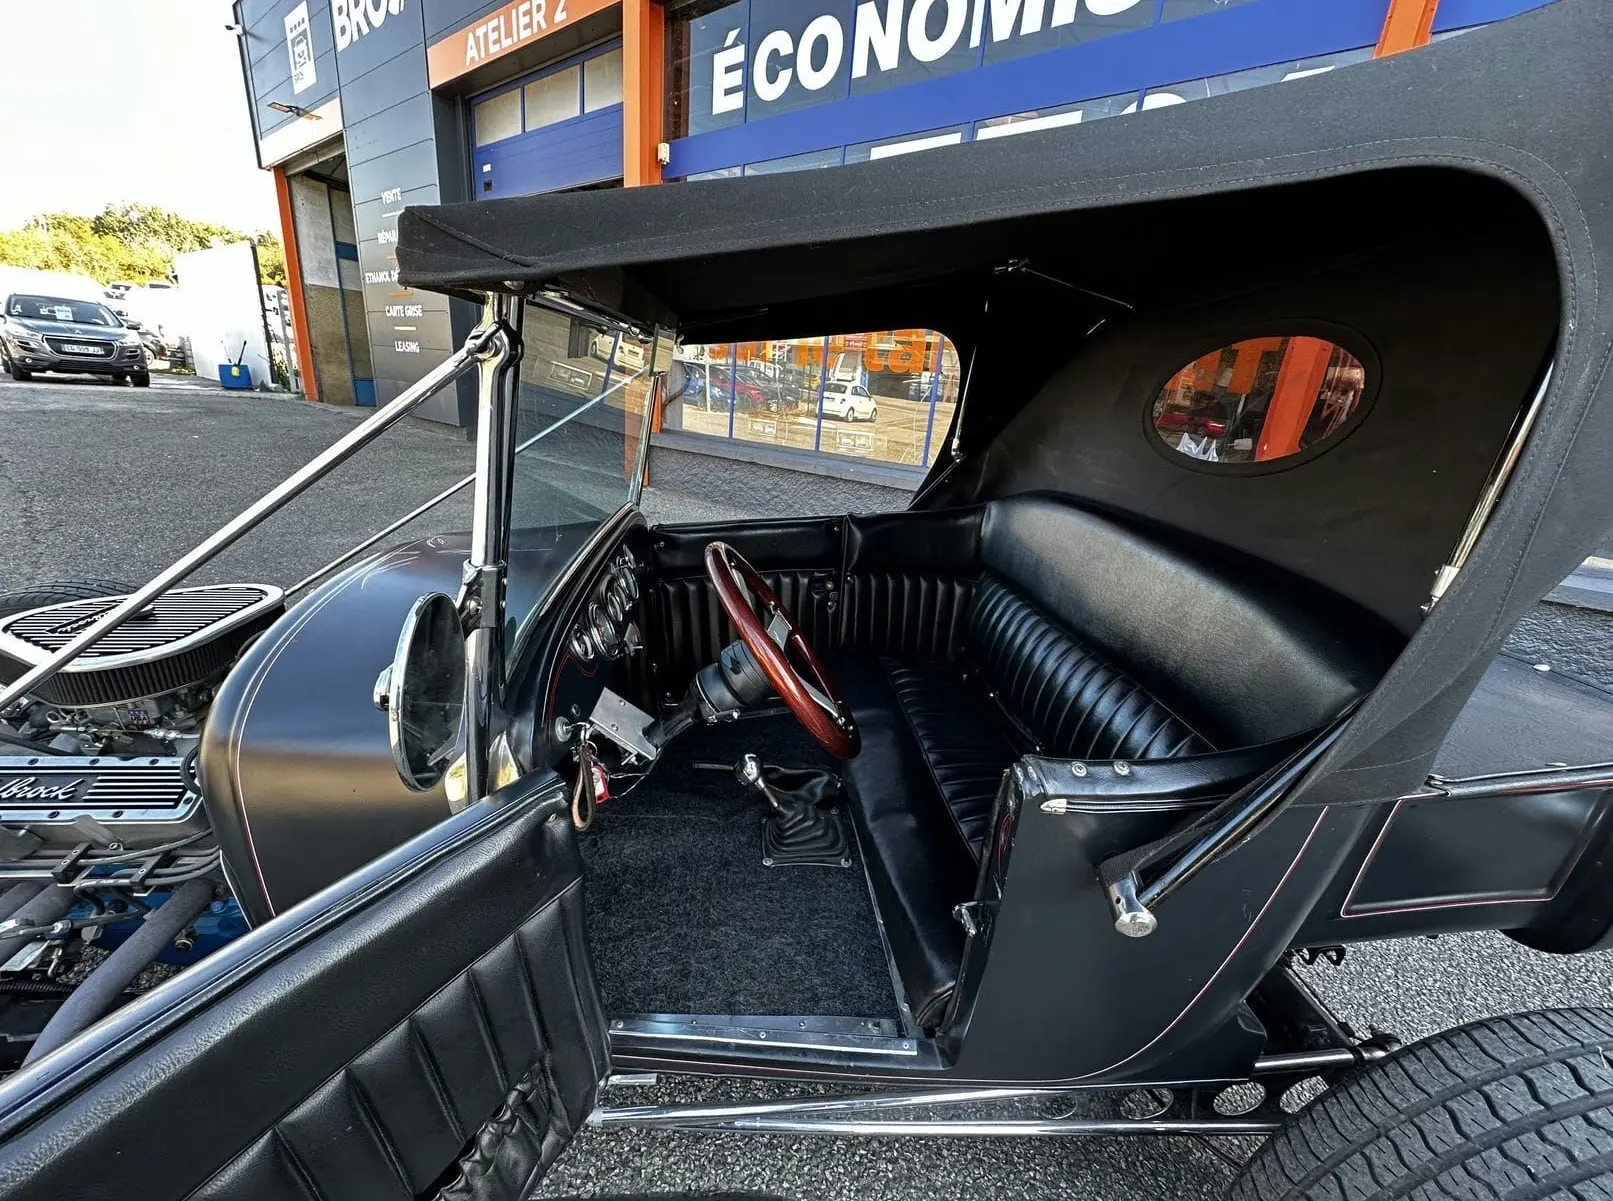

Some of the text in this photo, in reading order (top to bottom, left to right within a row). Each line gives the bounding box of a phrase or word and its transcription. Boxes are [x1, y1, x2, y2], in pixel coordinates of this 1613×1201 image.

[465, 0, 567, 66] ATELIER 2
[381, 187, 401, 205] VENTE
[385, 304, 422, 317] CARTE GRISE
[394, 340, 420, 353] LEASING
